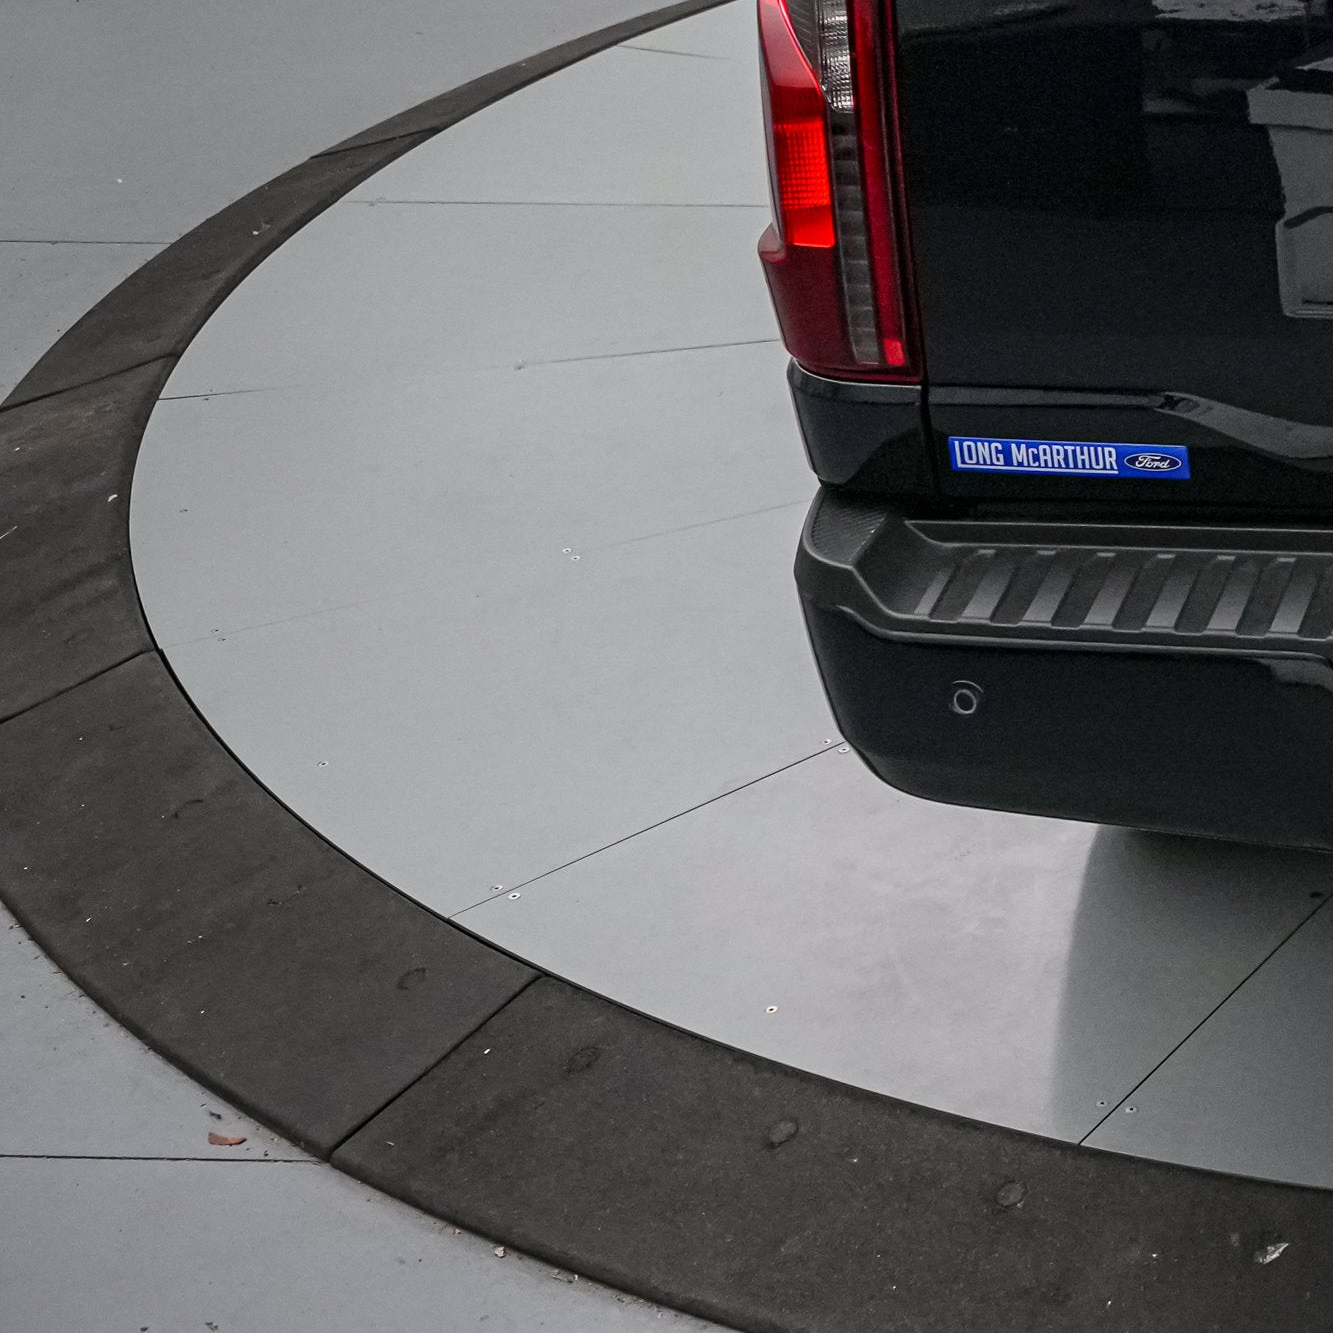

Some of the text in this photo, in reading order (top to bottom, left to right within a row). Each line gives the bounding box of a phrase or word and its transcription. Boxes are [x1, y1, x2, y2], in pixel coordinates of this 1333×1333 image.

[954, 439, 1170, 470] LONG McARTHUR Ford
